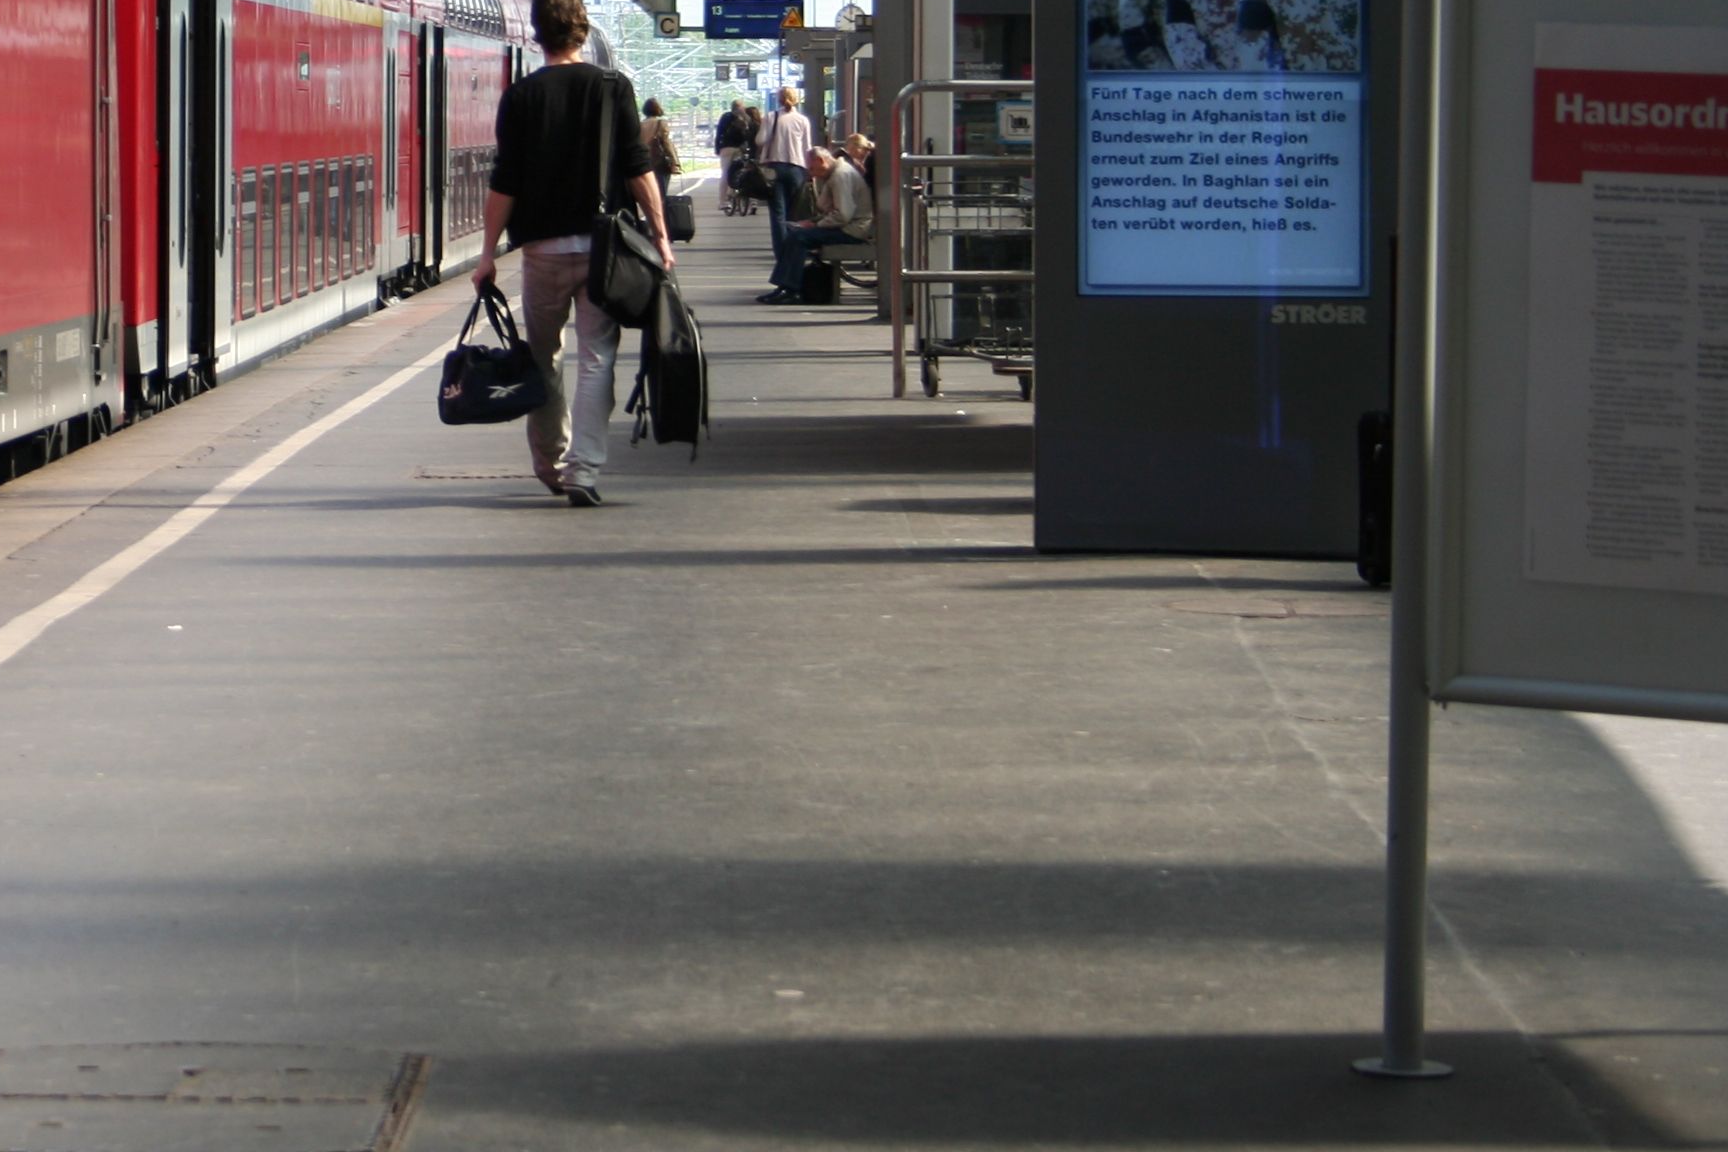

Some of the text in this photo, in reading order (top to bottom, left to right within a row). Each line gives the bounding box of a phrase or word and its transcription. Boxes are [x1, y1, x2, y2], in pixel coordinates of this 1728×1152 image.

[712, 5, 722, 16] 13
[660, 17, 676, 35] C
[1091, 87, 1344, 103] Fünf Tage nach dem schweren
[1091, 109, 1347, 124] Anschlag in Afghanistan ist die
[1091, 130, 1309, 147] Bundeswehr in der Region
[1091, 152, 1340, 168] erneut zum Ziel eines Angriffs
[1091, 174, 1329, 190] geworden. In Baghlan sei ein
[1091, 195, 1337, 211] Anschlag auf deutsche Solda-
[1091, 217, 1118, 230] ten
[1122, 217, 1175, 230] verübt
[1180, 217, 1247, 233] worden,
[1292, 219, 1317, 231] es.
[1270, 302, 1367, 325] STRÖER
